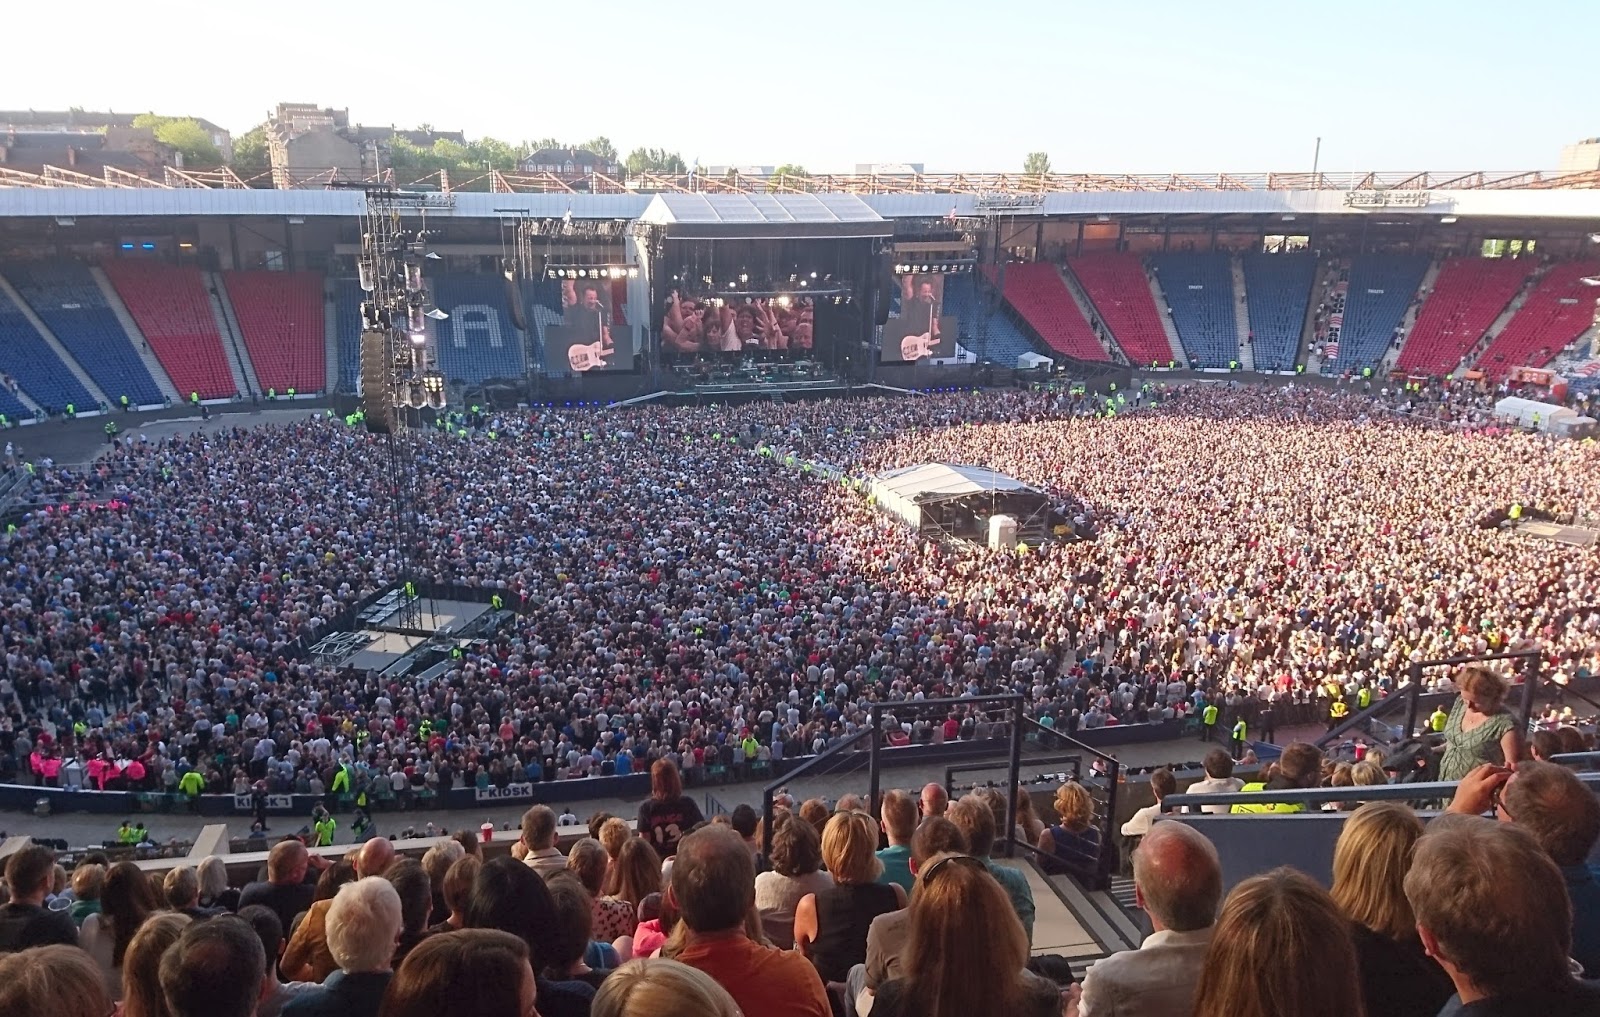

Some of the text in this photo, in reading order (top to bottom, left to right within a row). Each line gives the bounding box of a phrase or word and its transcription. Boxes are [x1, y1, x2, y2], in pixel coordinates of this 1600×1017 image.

[488, 786, 530, 798] KIOSK
[237, 797, 279, 807] KISK
[654, 823, 682, 844] 13
